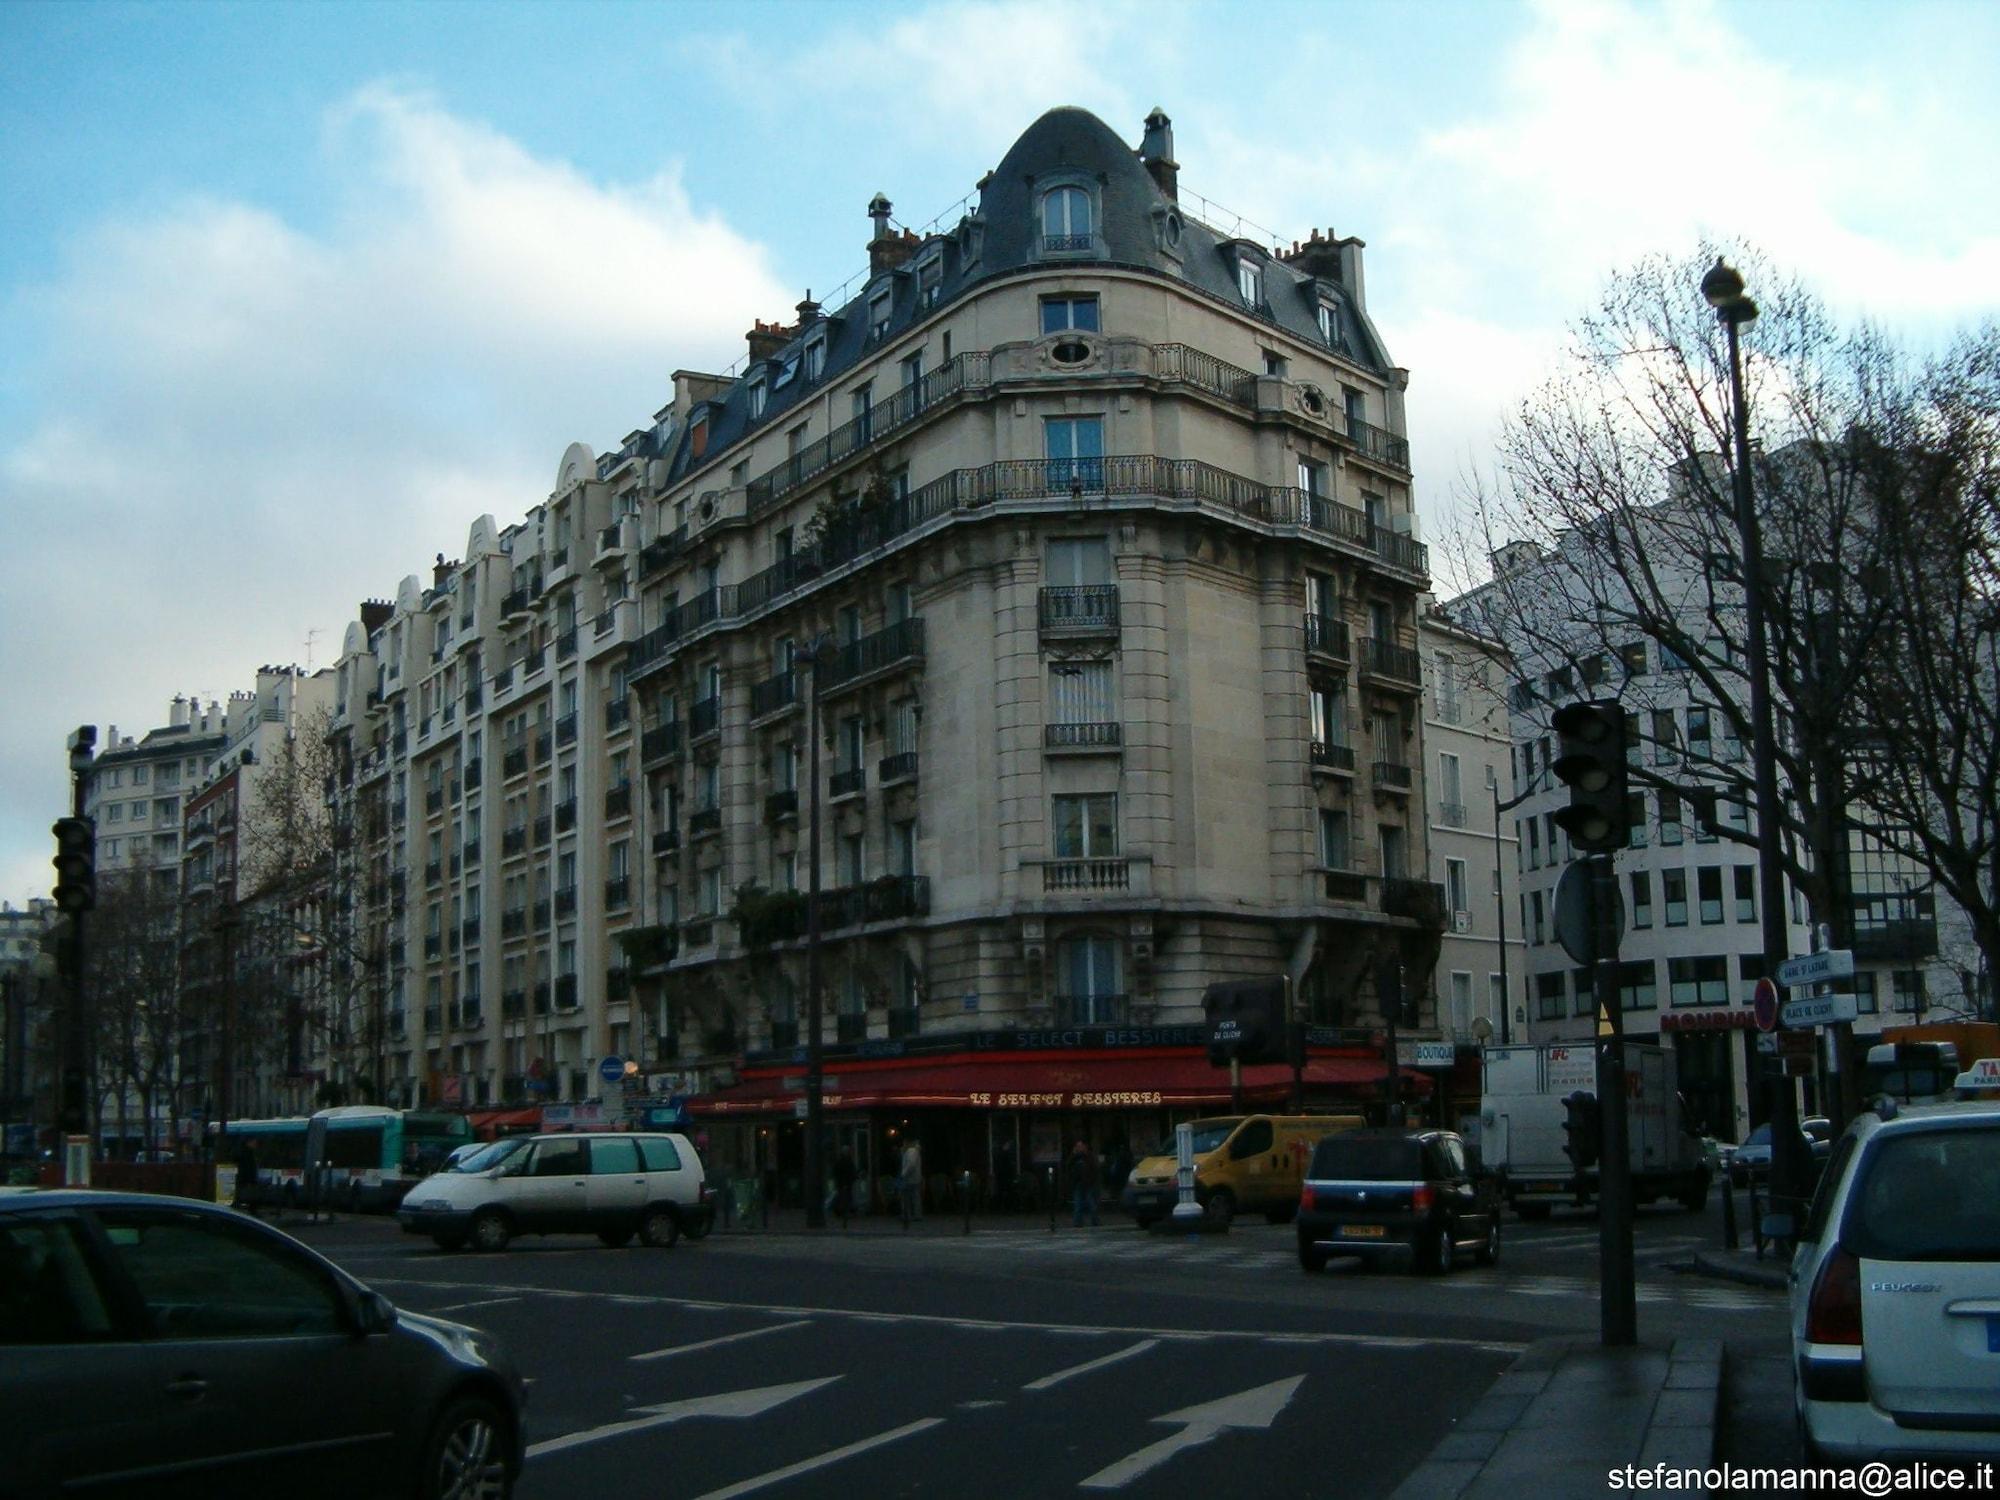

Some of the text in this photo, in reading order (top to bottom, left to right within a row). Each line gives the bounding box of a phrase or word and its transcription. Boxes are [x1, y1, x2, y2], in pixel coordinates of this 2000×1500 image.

[977, 1033, 993, 1048] LE
[1016, 1031, 1083, 1047] SELECT
[969, 1092, 992, 1106] LE
[1871, 1282, 1943, 1293] PEUGEOT
